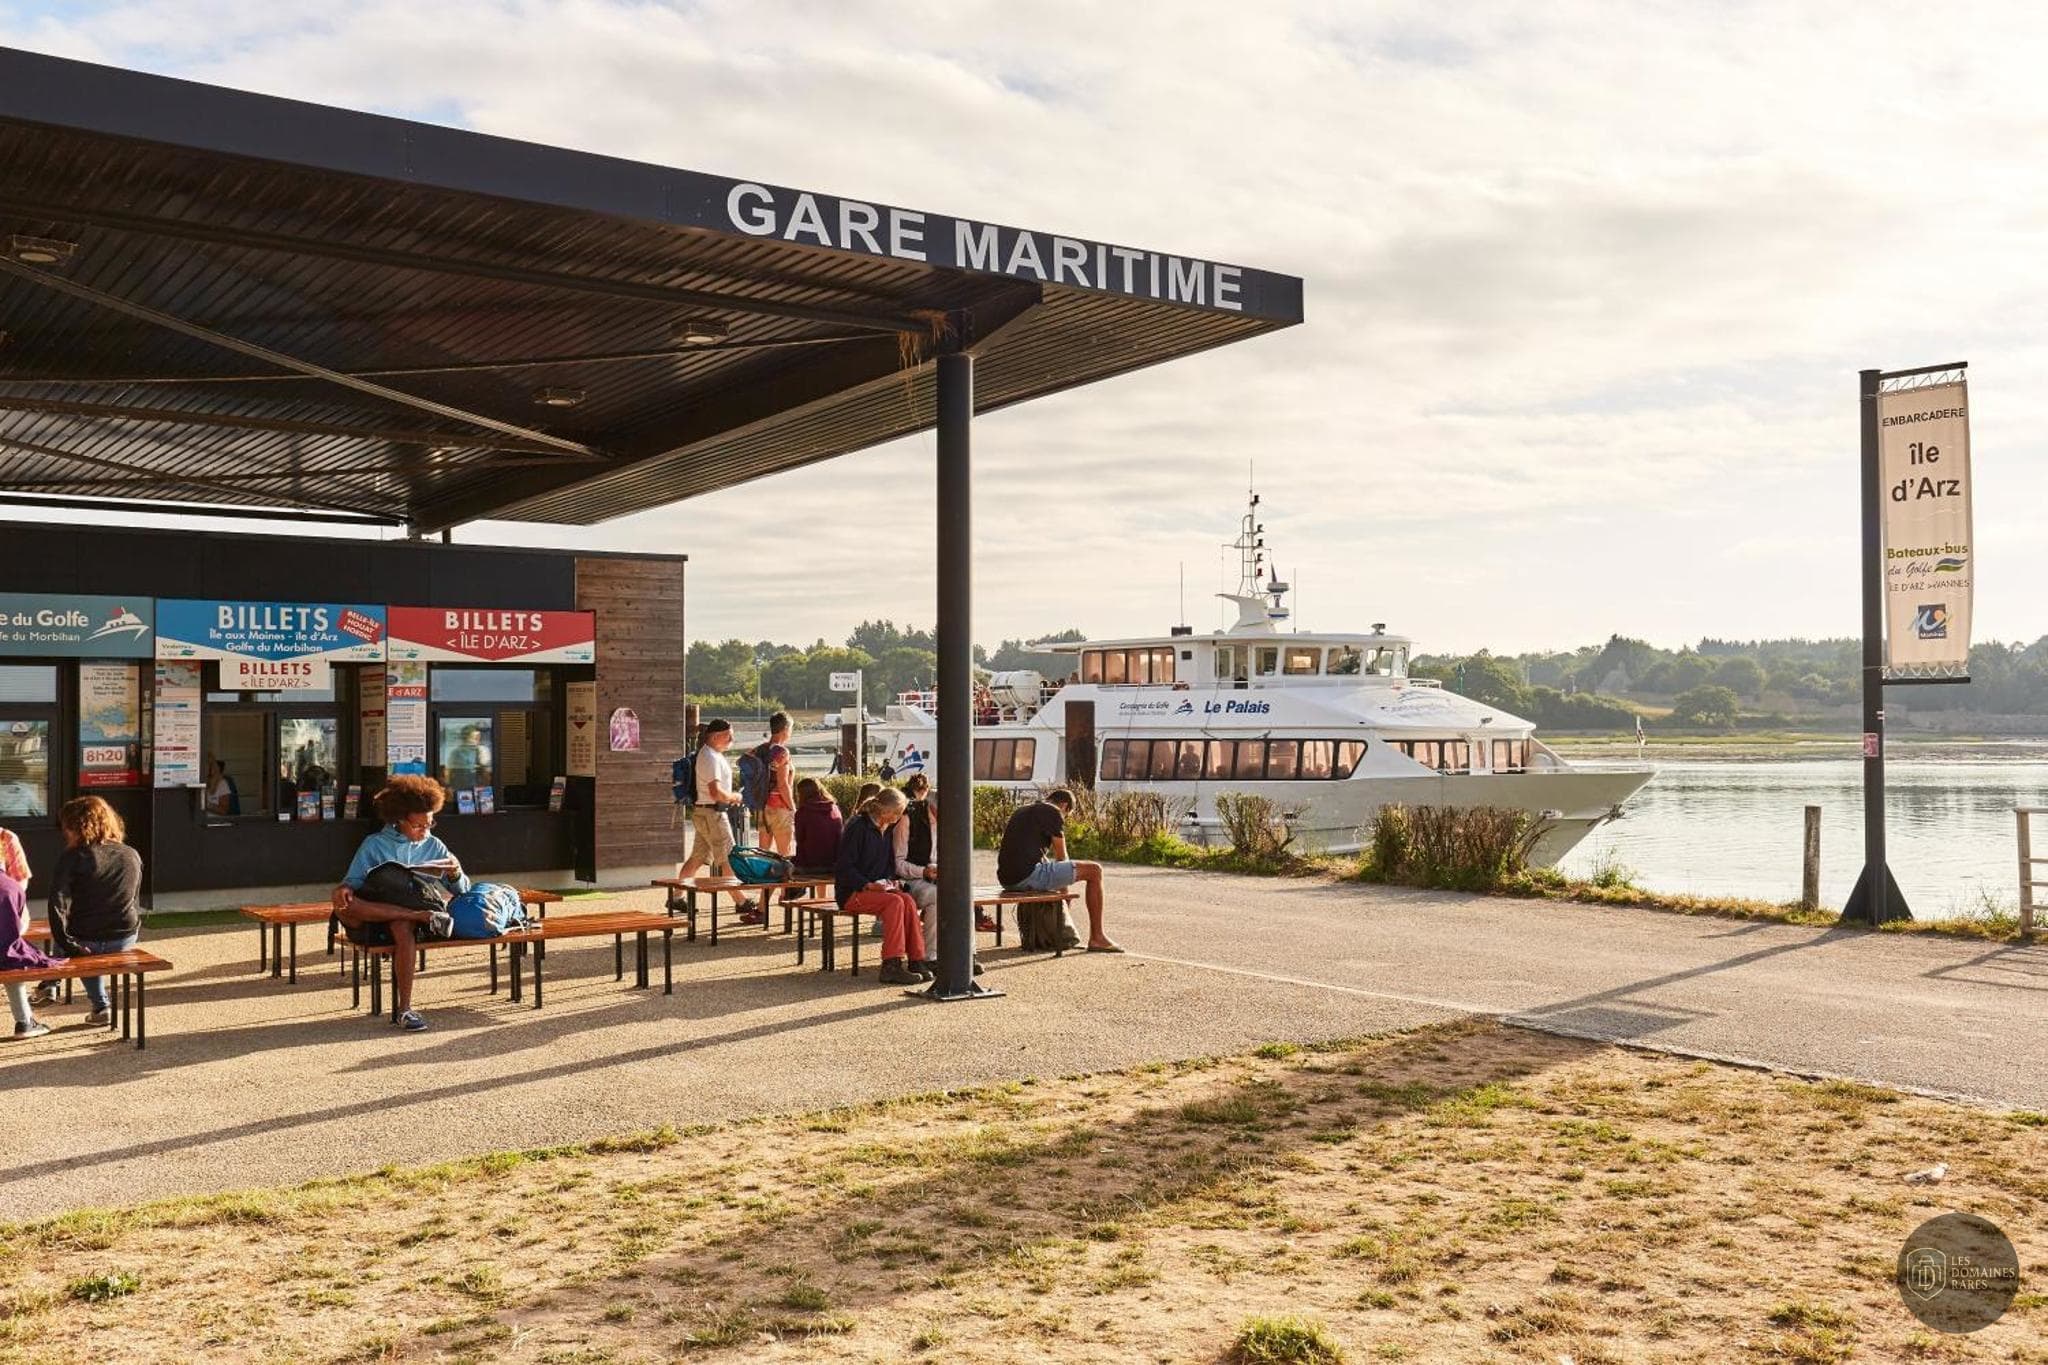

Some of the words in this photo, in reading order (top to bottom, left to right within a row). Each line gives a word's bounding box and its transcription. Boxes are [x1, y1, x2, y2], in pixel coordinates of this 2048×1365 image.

[727, 183, 927, 261] GARE
[954, 220, 1242, 311] MARITIME
[1882, 408, 1965, 427] EMBARCADERE
[1909, 442, 1940, 465] île
[1887, 542, 1968, 559] Bateaux-bus
[1887, 565, 1902, 576] du
[1905, 562, 1933, 578] Golfe
[12, 612, 32, 626] du
[37, 609, 89, 627] Golfe
[218, 606, 329, 631] BILLETS
[445, 611, 543, 631] BILLETS
[12, 631, 26, 641] du
[29, 631, 80, 643] Morbihan
[225, 632, 246, 640] aux
[248, 631, 285, 641] Moines
[460, 631, 479, 649] ÎLE
[484, 635, 528, 650] D'ARZ
[226, 642, 255, 652] Golfe
[257, 642, 271, 652] du
[273, 642, 323, 653] Morbihan
[240, 663, 312, 676] BILLETS
[250, 676, 265, 688] ÎLE
[268, 678, 300, 689] D'ARZ
[1204, 700, 1222, 714] Le
[1226, 700, 1271, 714] Palais
[86, 750, 123, 763] 8h20
